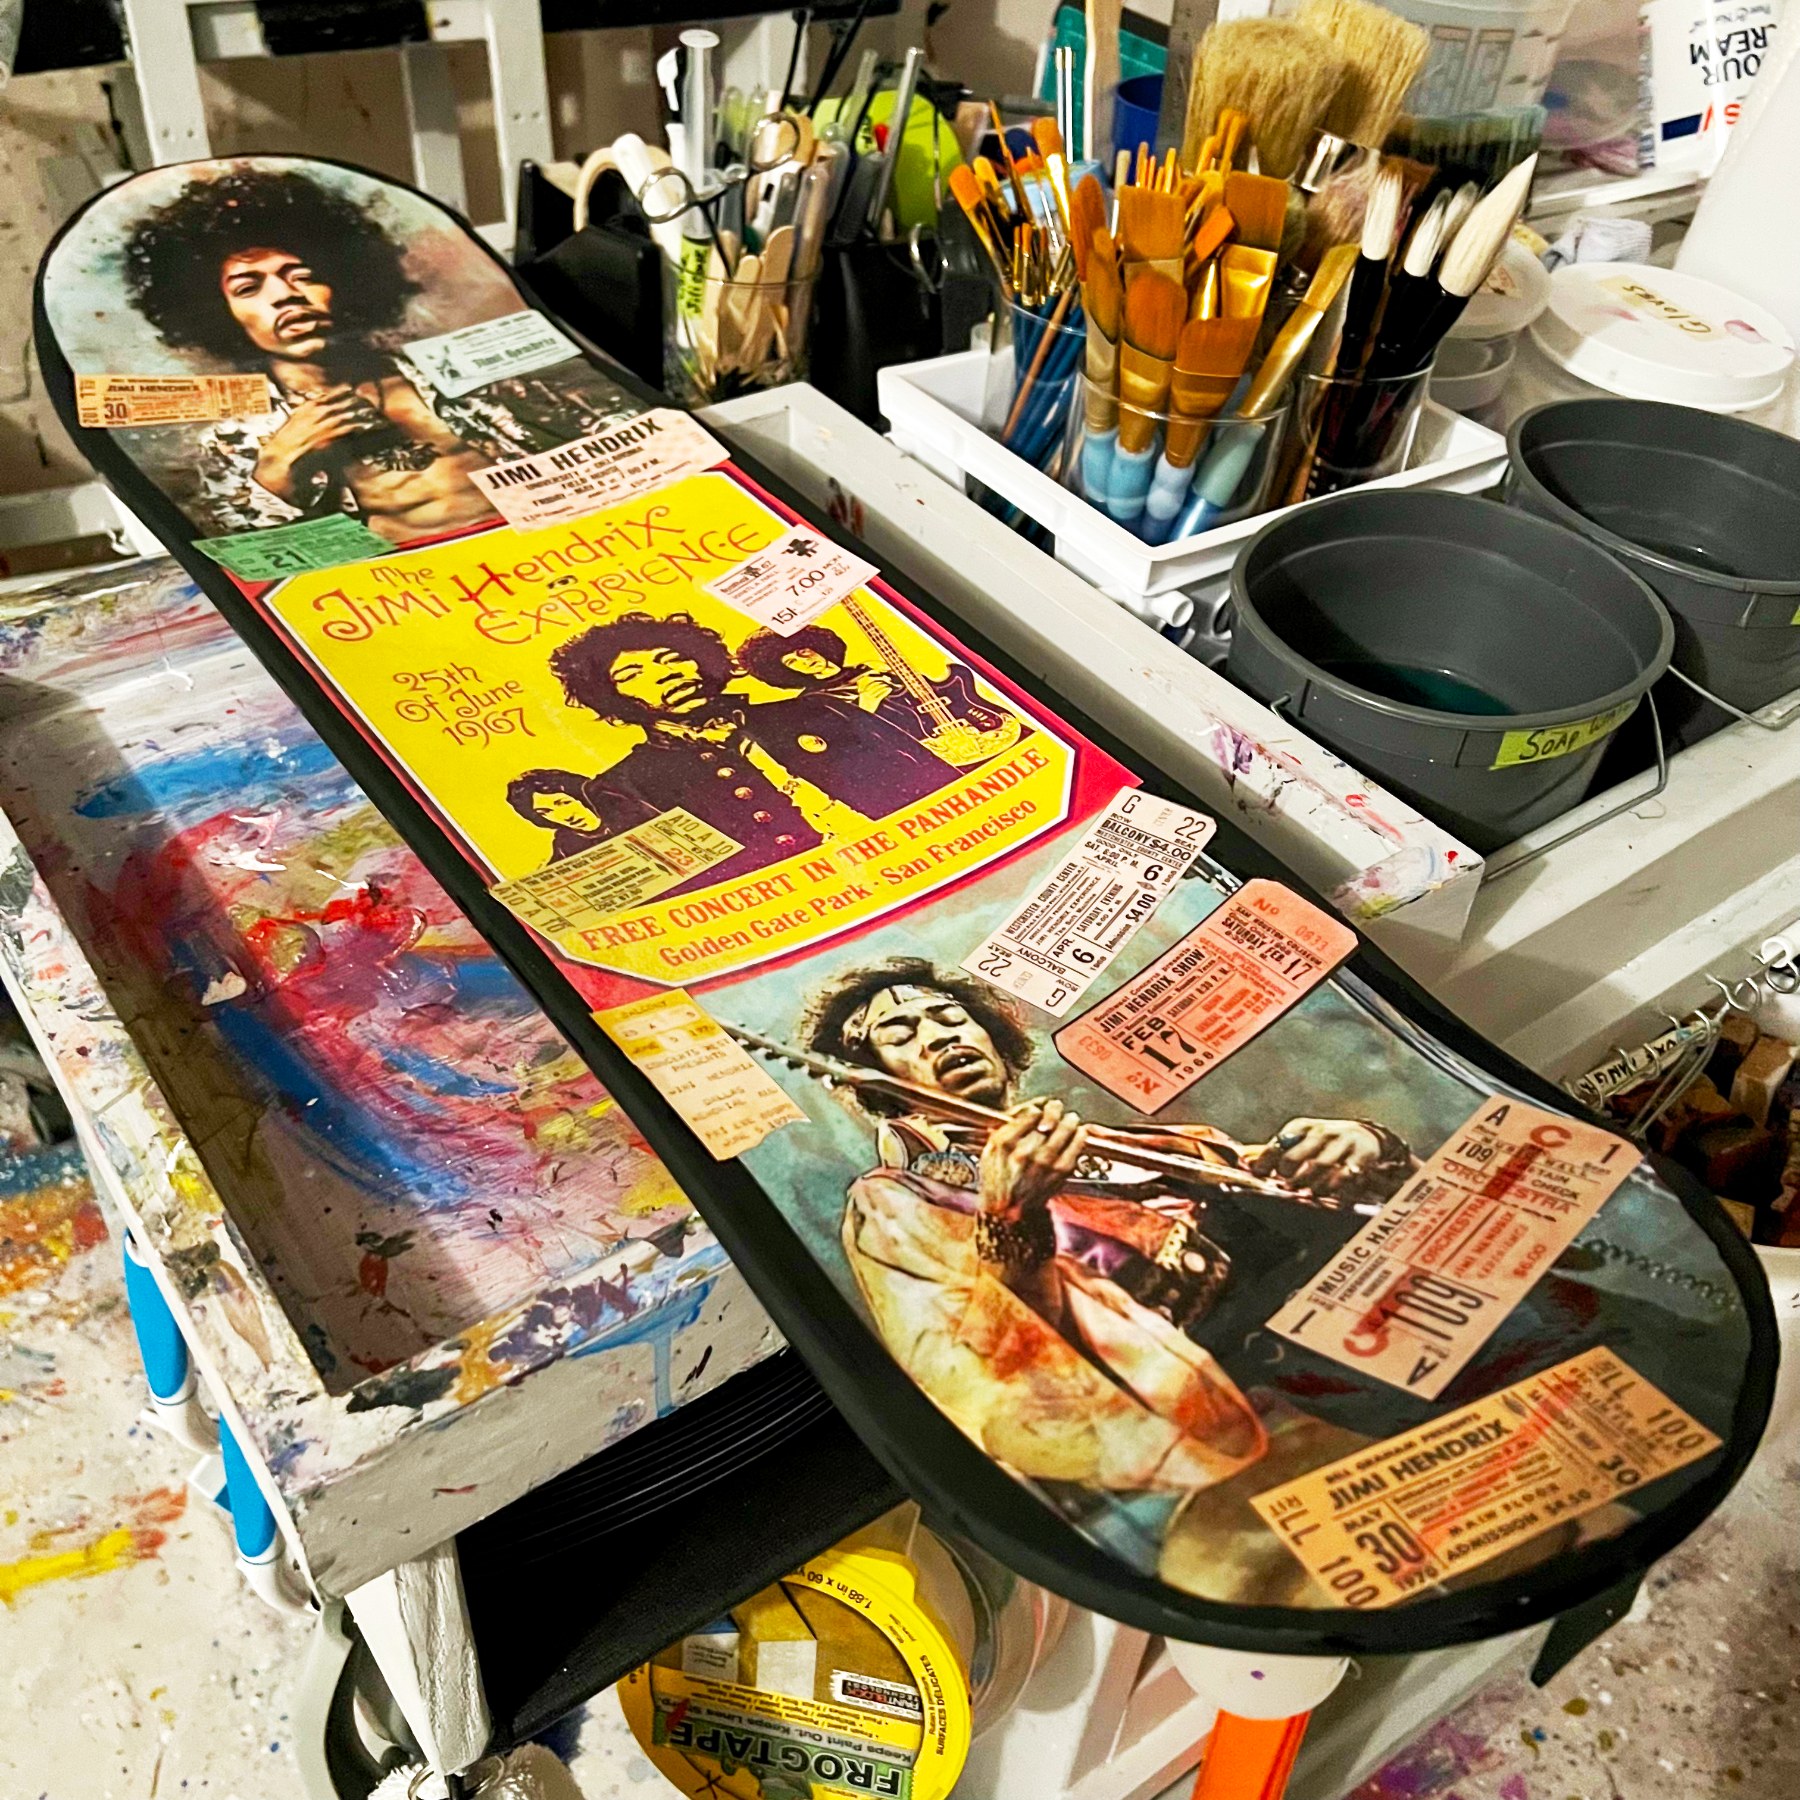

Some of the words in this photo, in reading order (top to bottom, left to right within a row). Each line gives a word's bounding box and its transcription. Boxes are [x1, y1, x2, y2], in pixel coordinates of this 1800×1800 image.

[1689, 25, 1777, 64] REAM
[486, 463, 541, 489] JIMI
[551, 418, 661, 469] HENDRIX
[370, 566, 435, 588] The
[785, 569, 825, 596] 7.00
[393, 662, 483, 693] 25th
[449, 680, 524, 718] June
[442, 707, 536, 749] 1967
[1101, 819, 1150, 843] BALCONY
[1121, 794, 1141, 813] G
[1174, 816, 1206, 840] 22
[579, 916, 667, 951] FREE
[668, 873, 797, 928] CONCERT
[800, 858, 837, 883] IN
[837, 831, 899, 867] THE
[896, 748, 1050, 840] PANHANDLE
[659, 928, 751, 967] Golden
[750, 909, 811, 939] Gate
[808, 883, 873, 918] Park
[879, 858, 931, 886] San
[926, 799, 1038, 864] Francisco
[1069, 876, 1100, 909] EXPERIENCE
[1143, 864, 1163, 881] 6
[1005, 902, 1039, 934] WESTCHESTER
[1056, 862, 1077, 881] CENTER
[1076, 906, 1102, 932] SATURDAY
[1100, 883, 1123, 905] EVENING
[1125, 893, 1156, 922] $4.00
[1221, 917, 1265, 948] SATURDAY
[1253, 918, 1283, 939] HOUSTON
[1286, 940, 1321, 965] COLISEUM
[978, 952, 1011, 977] 22
[1017, 947, 1065, 974] BALCONY
[1072, 948, 1094, 963] 6
[1282, 958, 1312, 980] 17
[1093, 995, 1129, 1022] Southwest
[1129, 972, 1160, 995] Concerts
[1161, 947, 1190, 971] presents
[1100, 1011, 1127, 1033] JIMI
[1125, 975, 1174, 1012] HENDRIX
[1171, 948, 1204, 976] SHOW
[1167, 993, 1196, 1017] SATURDAY
[1121, 1017, 1165, 1050] FEB
[1140, 1026, 1196, 1071] 17
[1484, 1104, 1510, 1126] A
[1529, 1124, 1571, 1148] C
[1456, 1141, 1493, 1162] 109
[1421, 1198, 1487, 1263] ORCHESTRA
[1316, 1246, 1370, 1294] MUSIC
[1365, 1209, 1410, 1244] HALL
[1338, 1255, 1386, 1301] PERFORMANCE
[1378, 1271, 1481, 1339] 109
[1406, 1356, 1438, 1385] A
[1648, 1408, 1706, 1450] 100
[1329, 1473, 1387, 1509] JIMI
[1389, 1420, 1510, 1480] HENDRIX
[1600, 1455, 1640, 1486] 30
[1343, 1508, 1381, 1532] MAY
[1447, 1513, 1538, 1560] ADMISSION
[1356, 1522, 1429, 1574] 30
[1318, 1554, 1381, 1608] 100
[669, 1721, 902, 1797] FROGTAPE
[827, 1736, 862, 1752] Paint
[867, 1746, 911, 1763] Keeps
